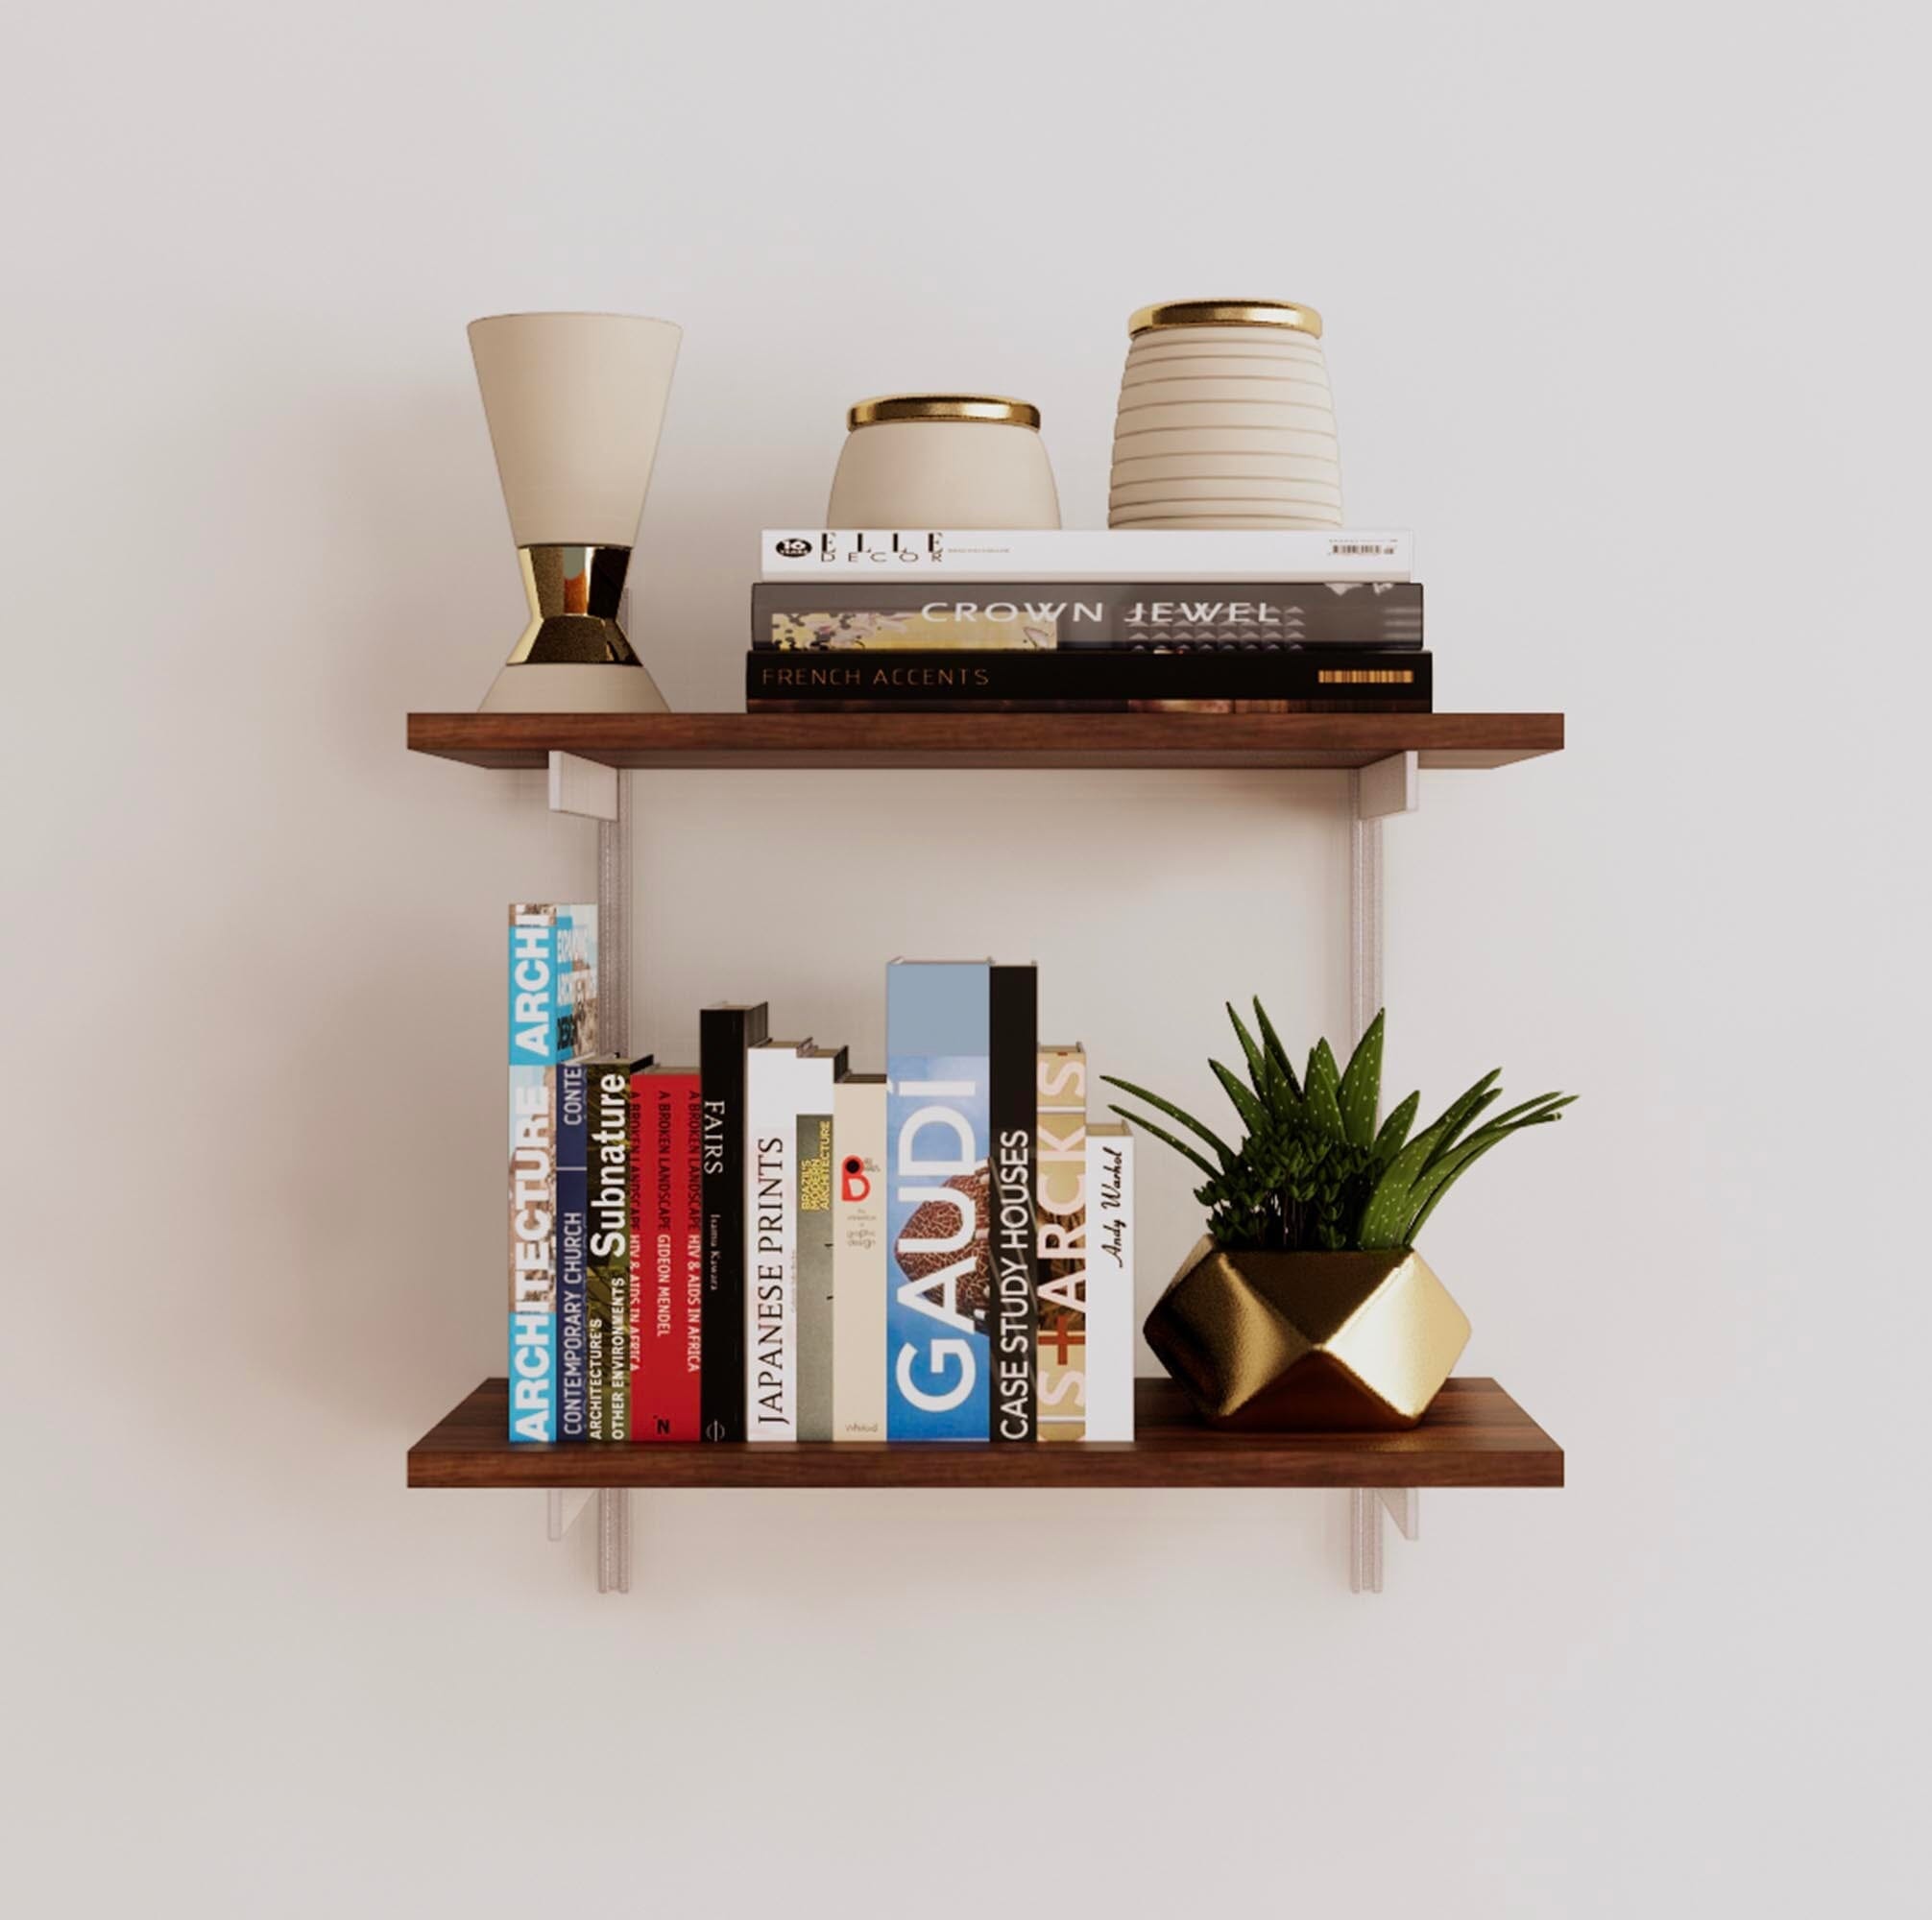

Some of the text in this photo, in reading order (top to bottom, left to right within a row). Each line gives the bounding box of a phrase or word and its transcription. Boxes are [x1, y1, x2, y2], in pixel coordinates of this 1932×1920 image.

[821, 533, 944, 553] ELLE
[821, 552, 943, 563] DECOR
[921, 602, 1280, 623] CROWN JEWEL
[762, 668, 990, 685] FRENCH ACCENTS
[563, 1064, 583, 1126] CONTE
[630, 1103, 641, 1155] BROKEN
[658, 1103, 671, 1155] BROKEN
[688, 1103, 701, 1155] BROKEN
[704, 1100, 725, 1175] FAIRS
[590, 1072, 626, 1258] Subnature
[819, 1120, 831, 1212] ARCHITECTURE
[630, 1158, 641, 1231] LANDSCAPE
[658, 1158, 671, 1231] LANDSCAPE
[688, 1158, 701, 1231] LANDSCAPE
[1100, 1146, 1127, 1268] Andy Warhol
[515, 1086, 550, 1442] ARCHITECTURE
[630, 1234, 641, 1259] HIV
[658, 1234, 671, 1284] GIDEON
[688, 1234, 701, 1259] HIV
[630, 1274, 641, 1307] AIDS
[688, 1274, 701, 1307] AIDS
[758, 1137, 790, 1426] JAPANESE PRINTS
[1000, 1129, 1029, 1440] CASE STUDY HOUSES
[563, 1212, 583, 1435] CONTEMPORARY CHURCH
[630, 1308, 641, 1323] IN
[658, 1286, 671, 1337] MENDEL
[688, 1308, 701, 1323] IN
[611, 1277, 625, 1440] OTHER ENVIRONMENTS
[630, 1325, 641, 1374] AFRICA
[688, 1325, 701, 1374] AFRICA
[589, 1317, 603, 1440] ARCHITECTURE'S
